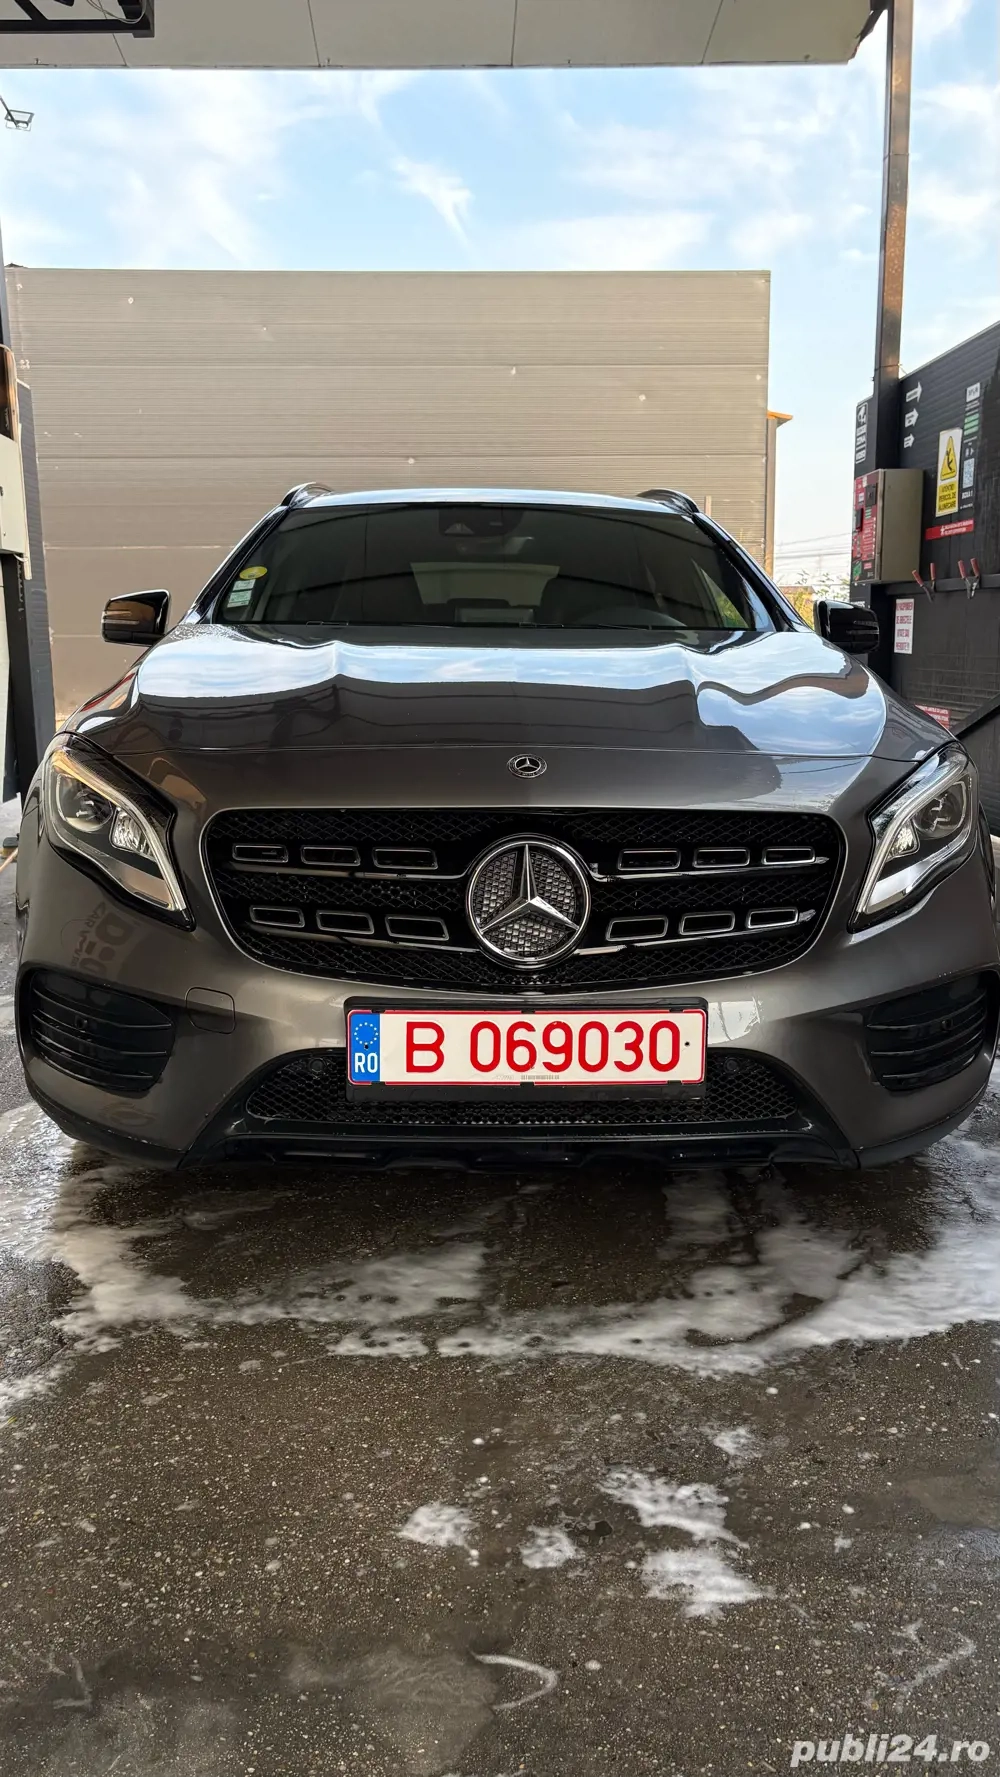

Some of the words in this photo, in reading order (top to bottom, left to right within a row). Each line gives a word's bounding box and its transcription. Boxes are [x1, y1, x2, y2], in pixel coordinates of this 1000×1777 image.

[354, 1052, 379, 1074] RO
[406, 1021, 445, 1073] B
[470, 1019, 681, 1073] 069030
